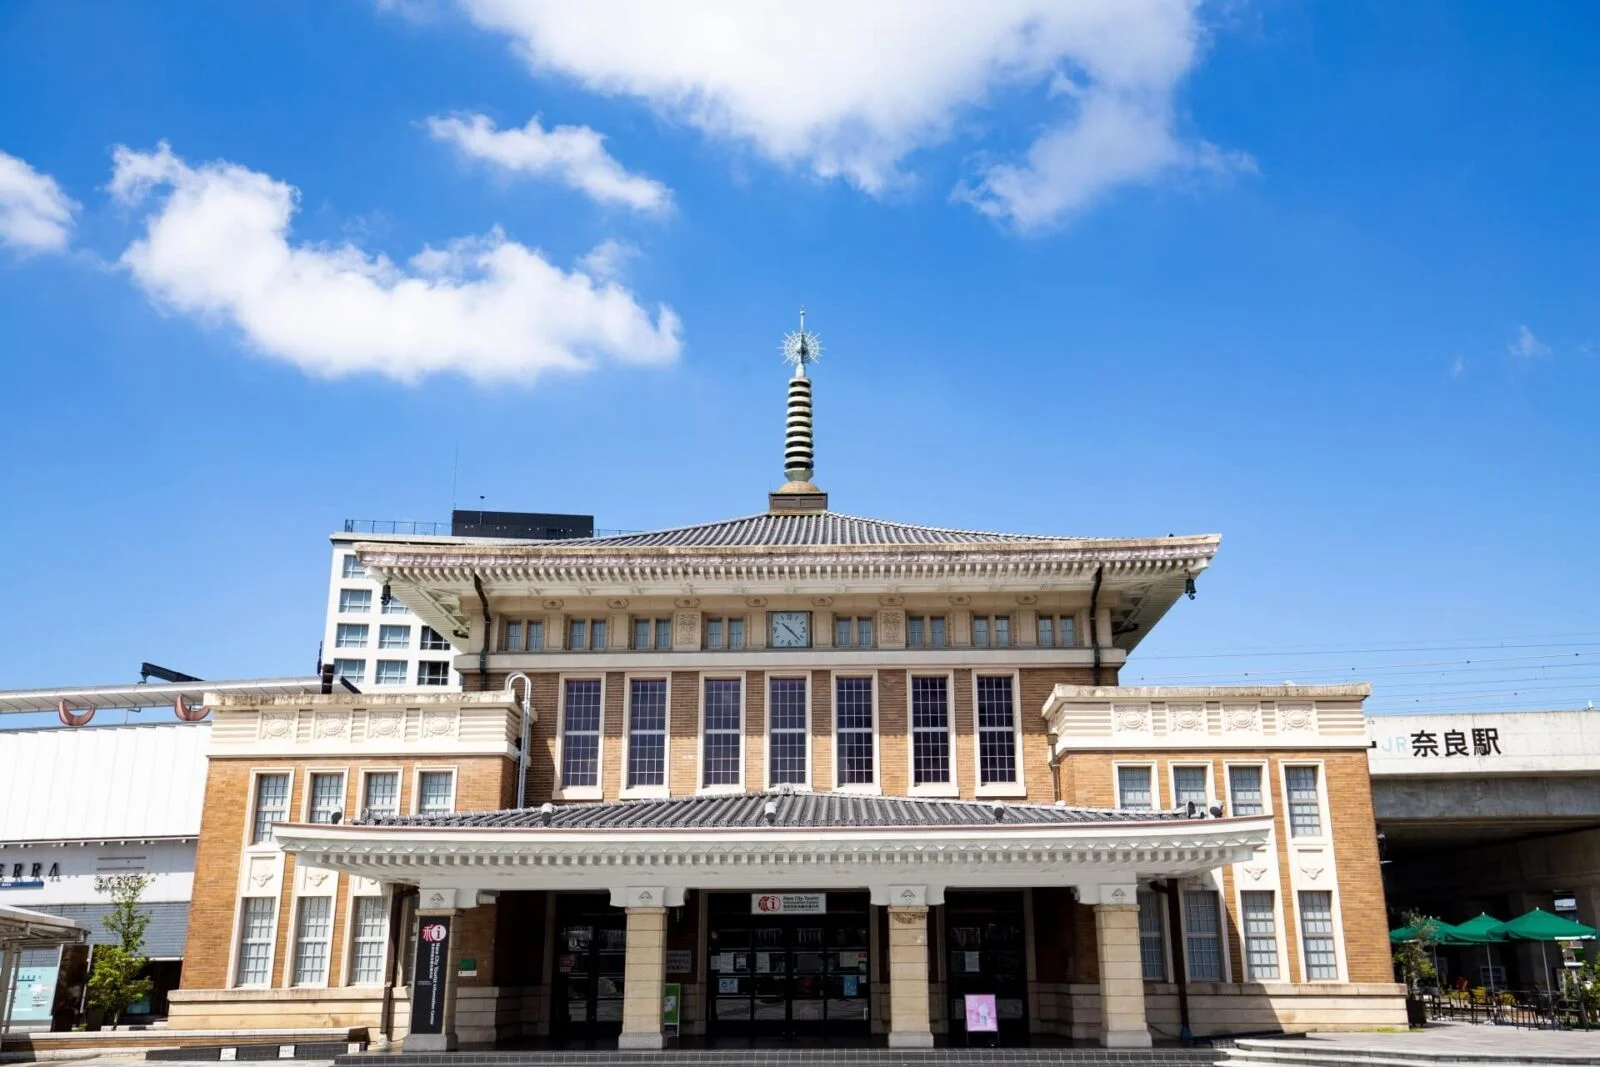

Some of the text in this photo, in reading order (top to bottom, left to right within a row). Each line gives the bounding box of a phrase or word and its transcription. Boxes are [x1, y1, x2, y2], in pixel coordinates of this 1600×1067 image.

[1381, 736, 1408, 752] JR
[1411, 728, 1501, 757] 奈良駅
